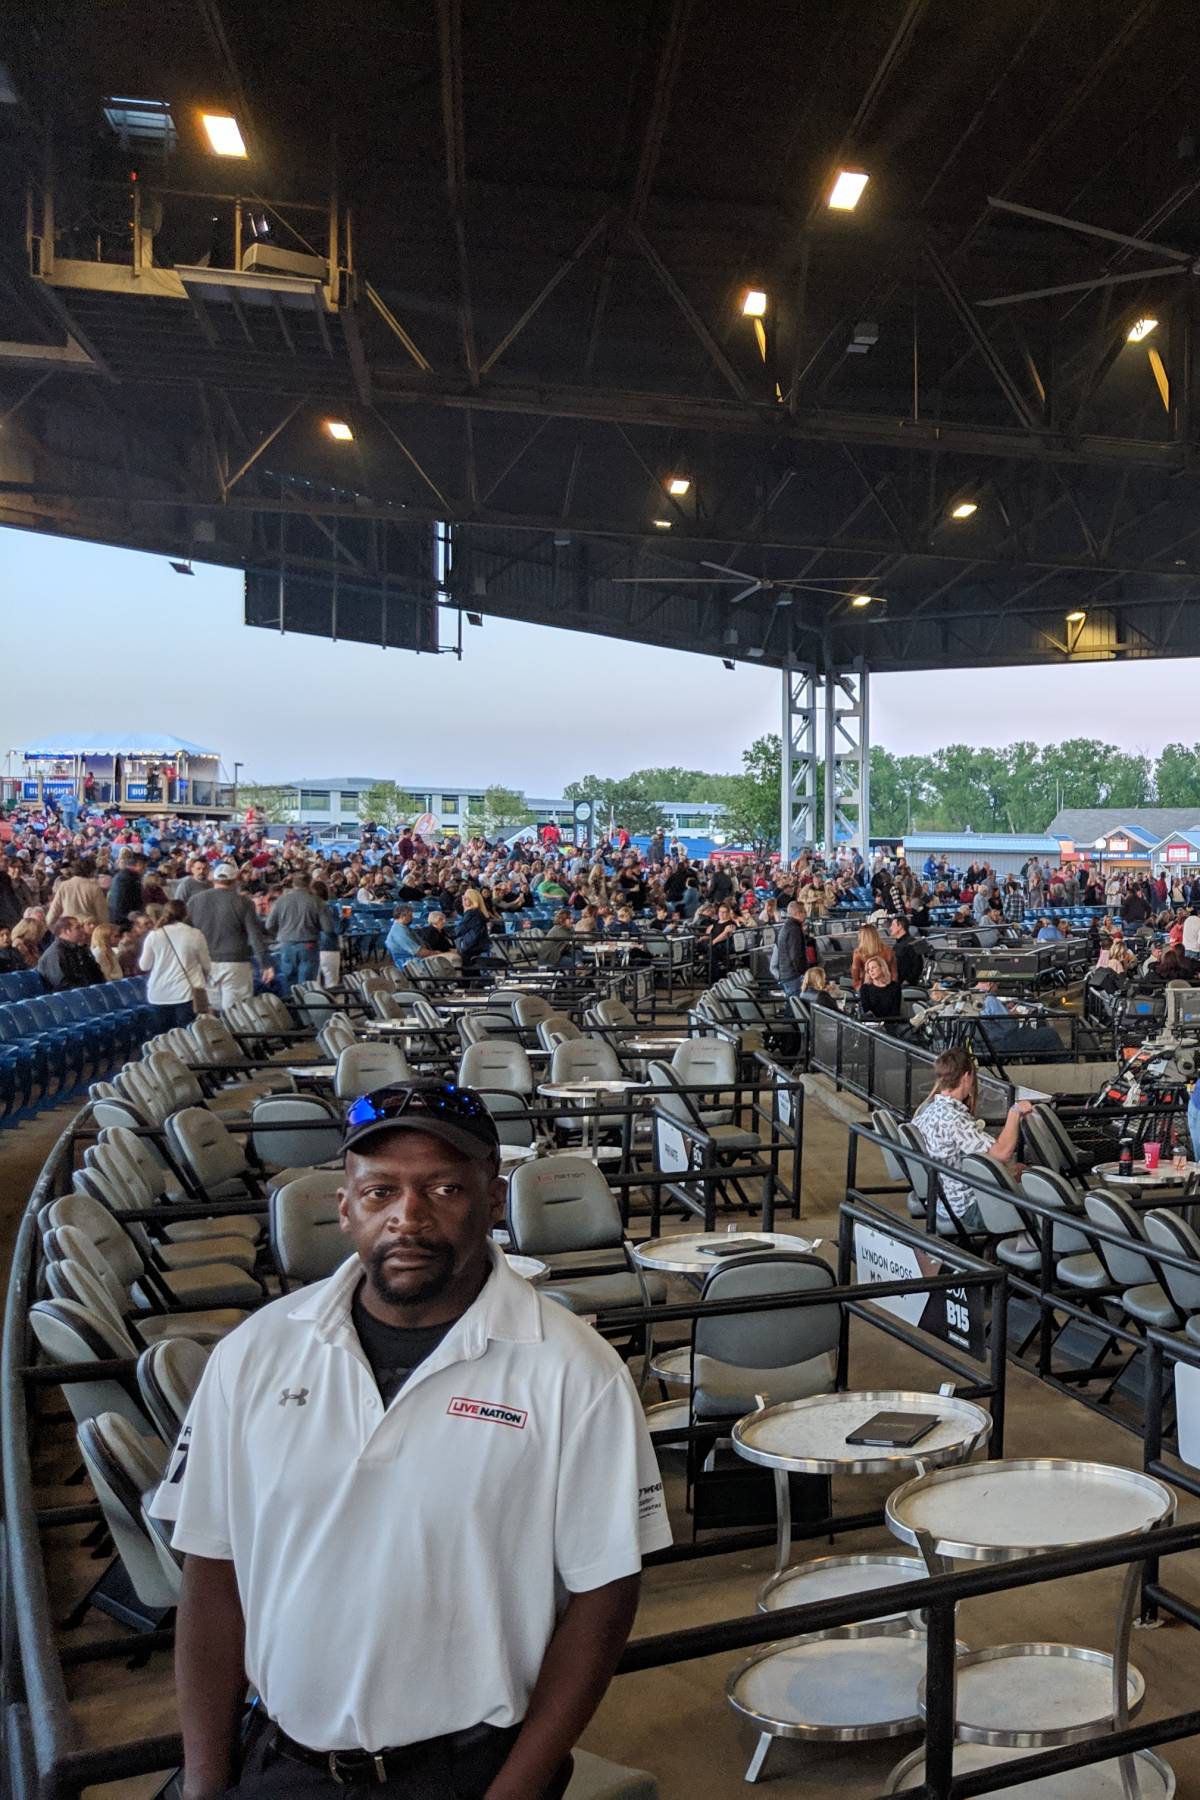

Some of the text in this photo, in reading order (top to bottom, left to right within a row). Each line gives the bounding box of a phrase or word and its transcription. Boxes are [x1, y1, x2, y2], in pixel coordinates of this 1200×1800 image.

[861, 1247, 913, 1280] LYNDON GROSS
[946, 1299, 970, 1333] B15
[453, 1402, 522, 1424] LIVE NATION
